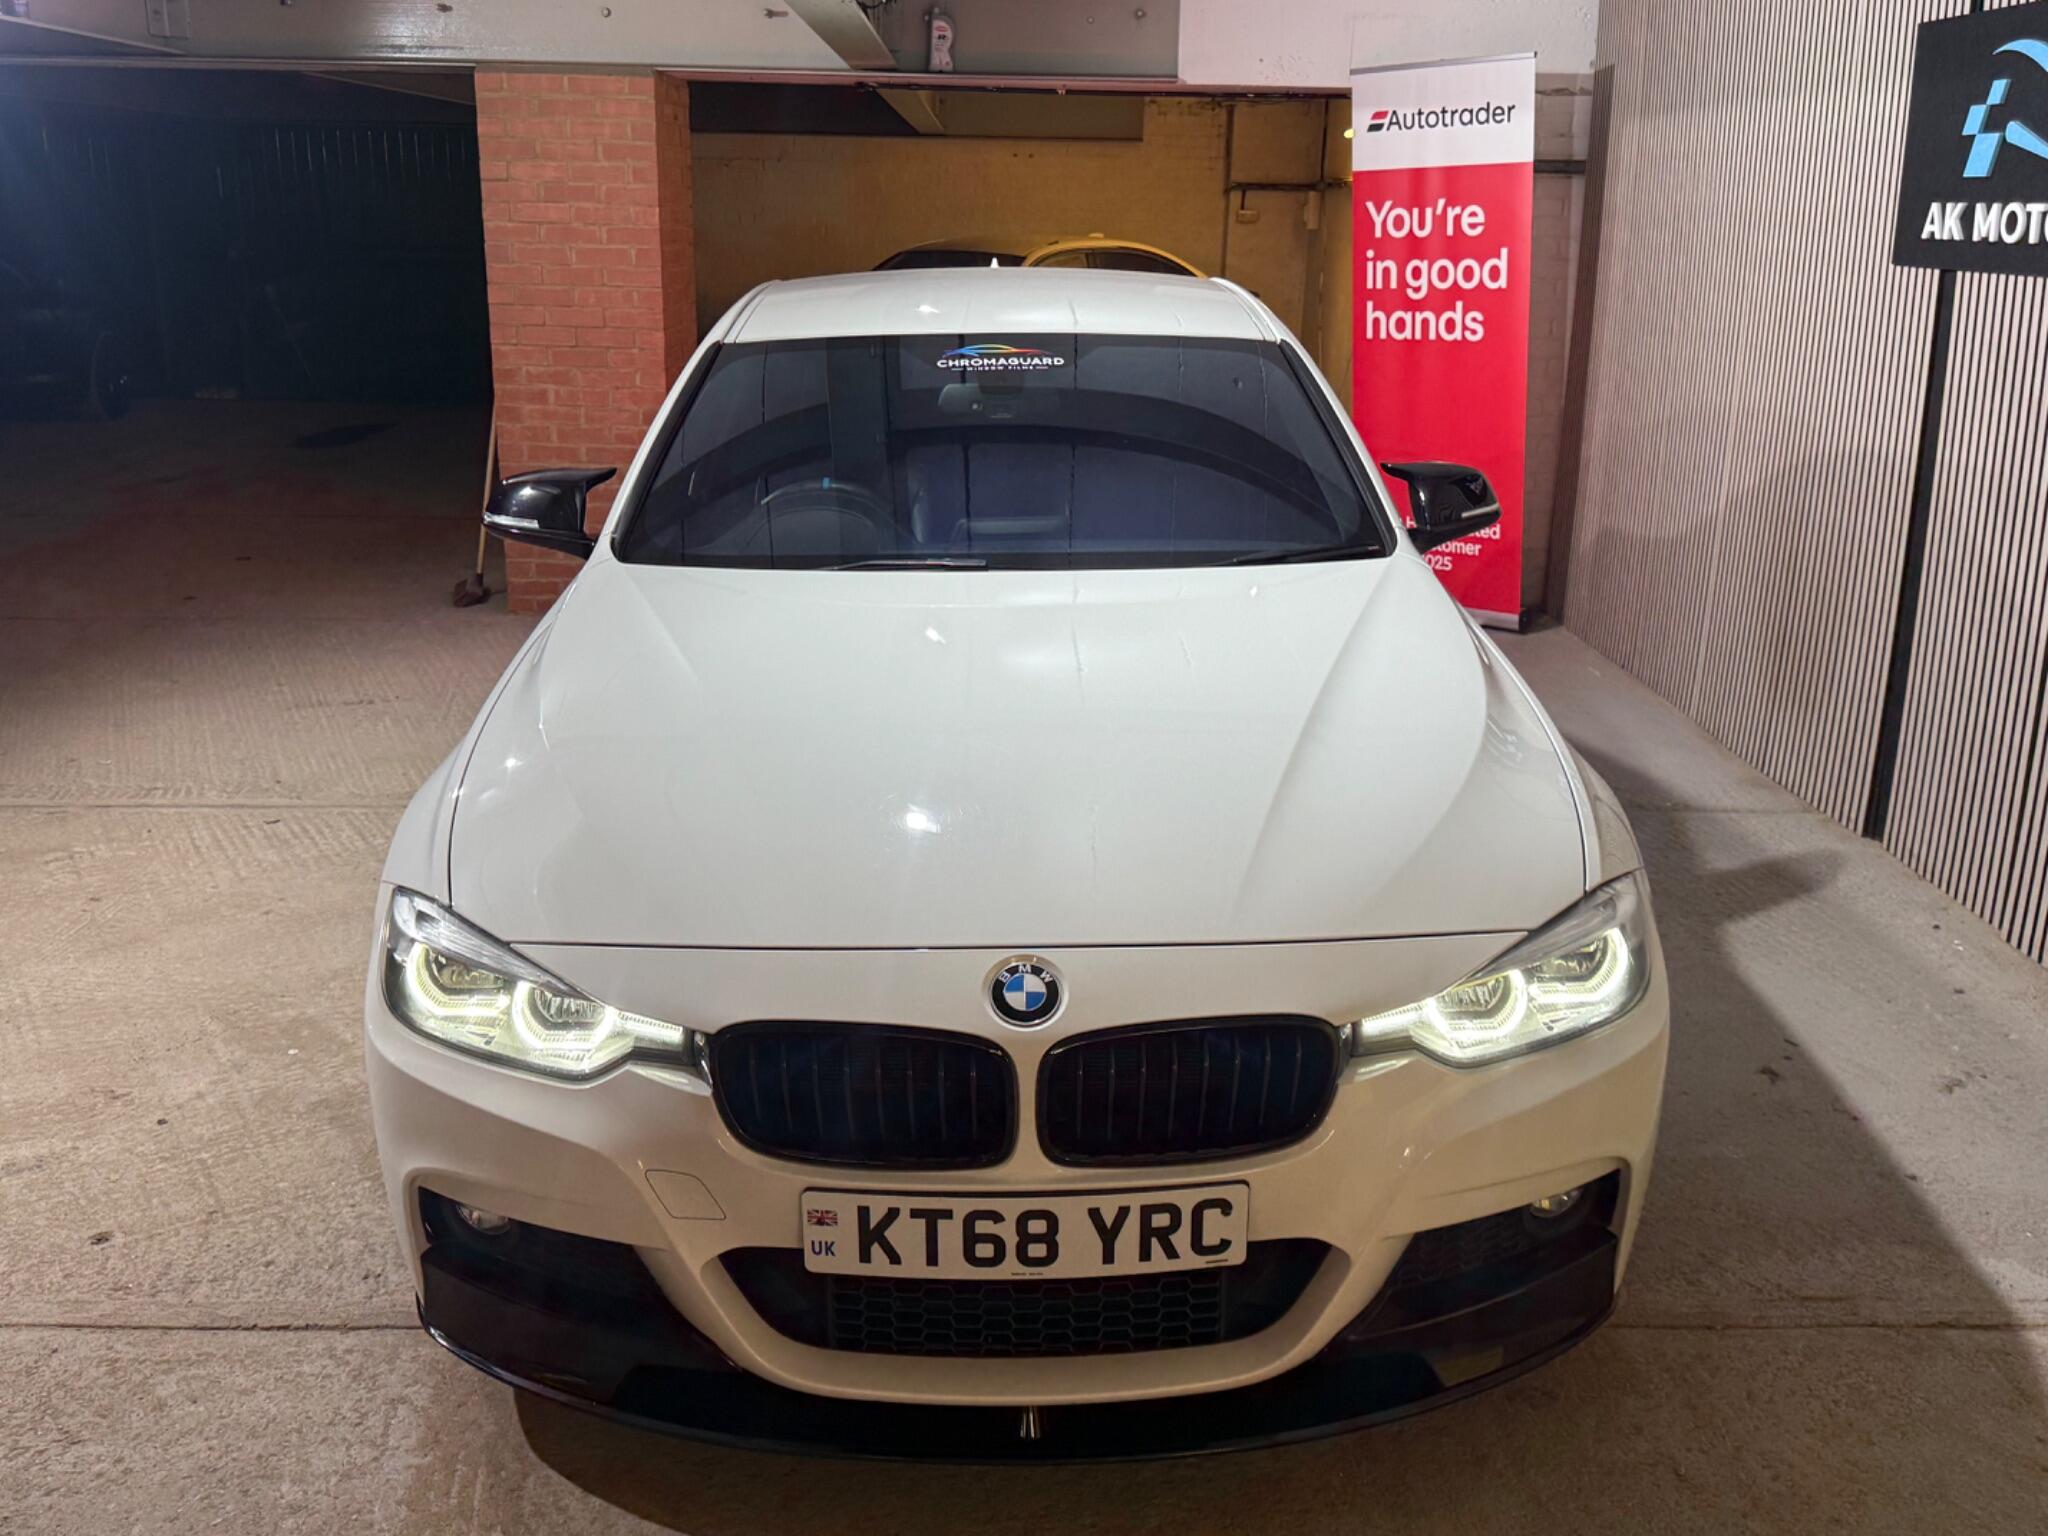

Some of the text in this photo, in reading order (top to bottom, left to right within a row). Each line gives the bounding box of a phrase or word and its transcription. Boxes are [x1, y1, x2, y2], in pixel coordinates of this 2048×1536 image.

[1387, 102, 1515, 131] Autotrader
[1365, 198, 1485, 238] You're
[1921, 202, 2048, 244] AK MOT
[1366, 247, 1508, 300] in good
[1366, 300, 1484, 342] hands
[936, 357, 1065, 368] CHROMAGUARD
[1423, 553, 1453, 571] 025
[1000, 963, 1053, 982] BMW
[811, 1240, 836, 1257] UK
[857, 1197, 1234, 1268] KT68 YRC
